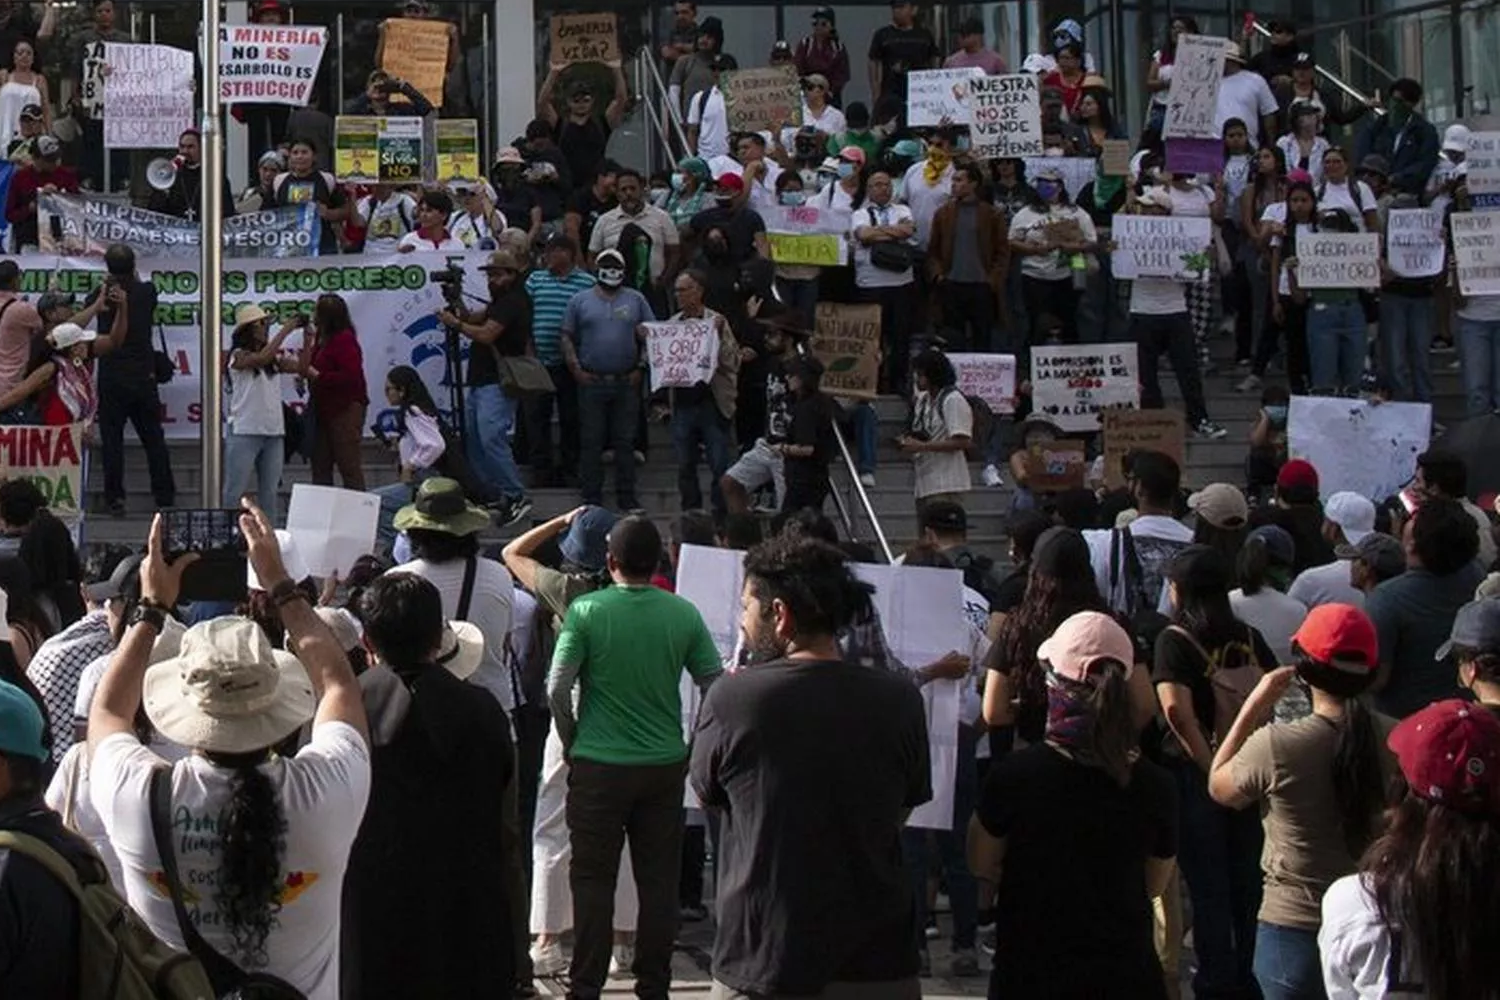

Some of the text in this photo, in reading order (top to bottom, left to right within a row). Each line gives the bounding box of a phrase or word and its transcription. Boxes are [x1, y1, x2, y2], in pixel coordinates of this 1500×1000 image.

[234, 28, 320, 44] MINERÍA
[232, 46, 291, 61] NO ES
[219, 63, 312, 79] ESARROLLO ES
[970, 77, 1035, 93] NUESTRA
[976, 92, 1029, 106] TIERRA
[976, 106, 1019, 121] NO SE
[975, 121, 1029, 135] VENDE
[85, 218, 143, 241] VIDA
[223, 230, 311, 248] TESORO
[1314, 240, 1347, 258] AGUA
[152, 271, 200, 295] NO
[254, 265, 427, 293] PROGRESO
